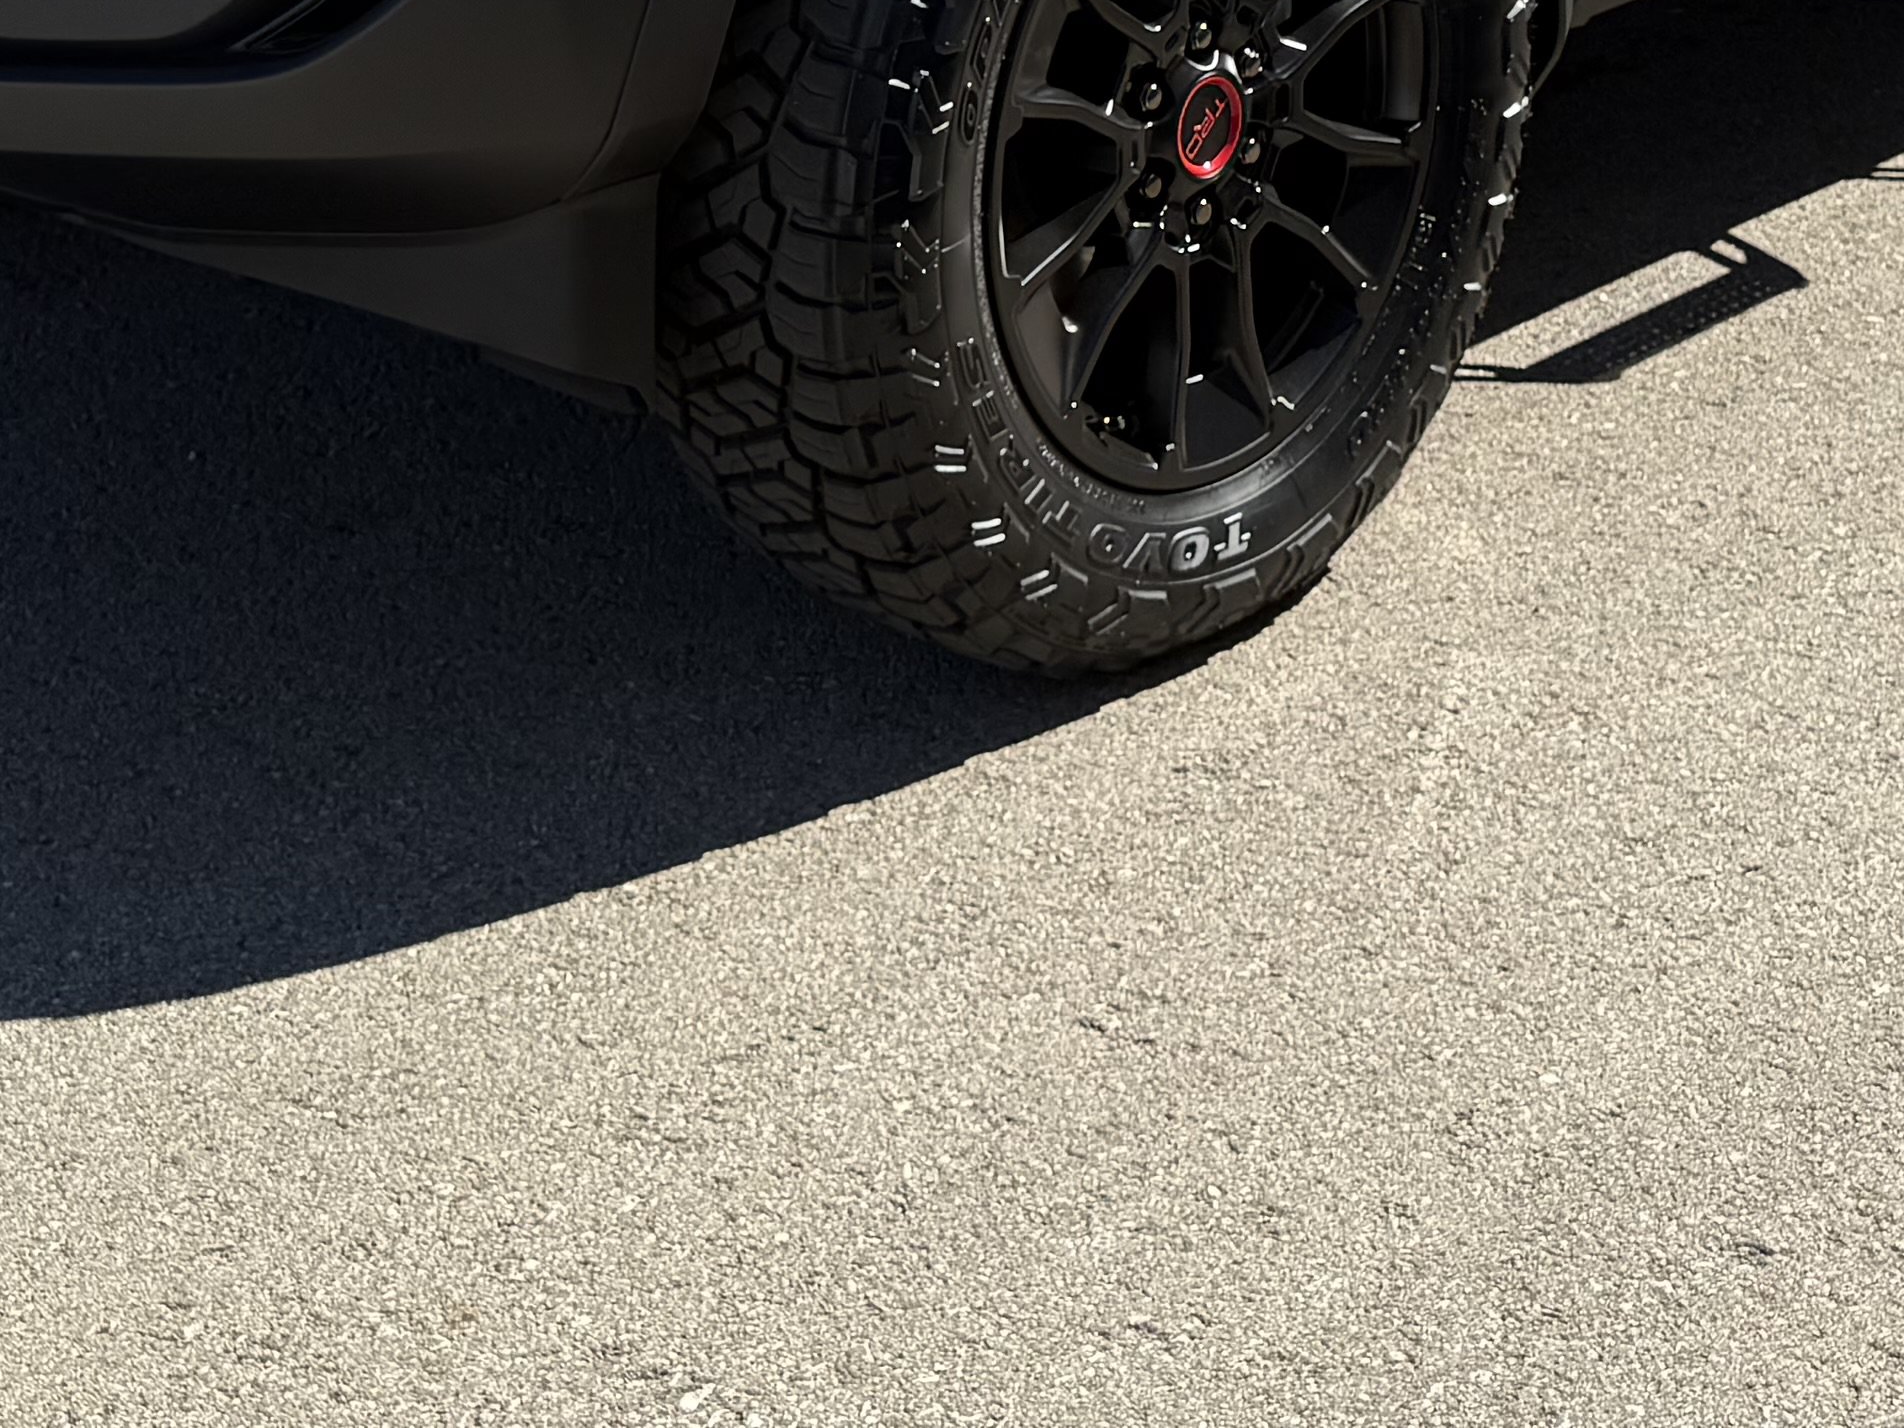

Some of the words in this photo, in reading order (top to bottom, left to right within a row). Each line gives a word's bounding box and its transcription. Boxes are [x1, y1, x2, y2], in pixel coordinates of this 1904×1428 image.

[1185, 97, 1229, 161] TRD
[957, 338, 1082, 543] TIRES
[1088, 511, 1253, 572] TOYO
